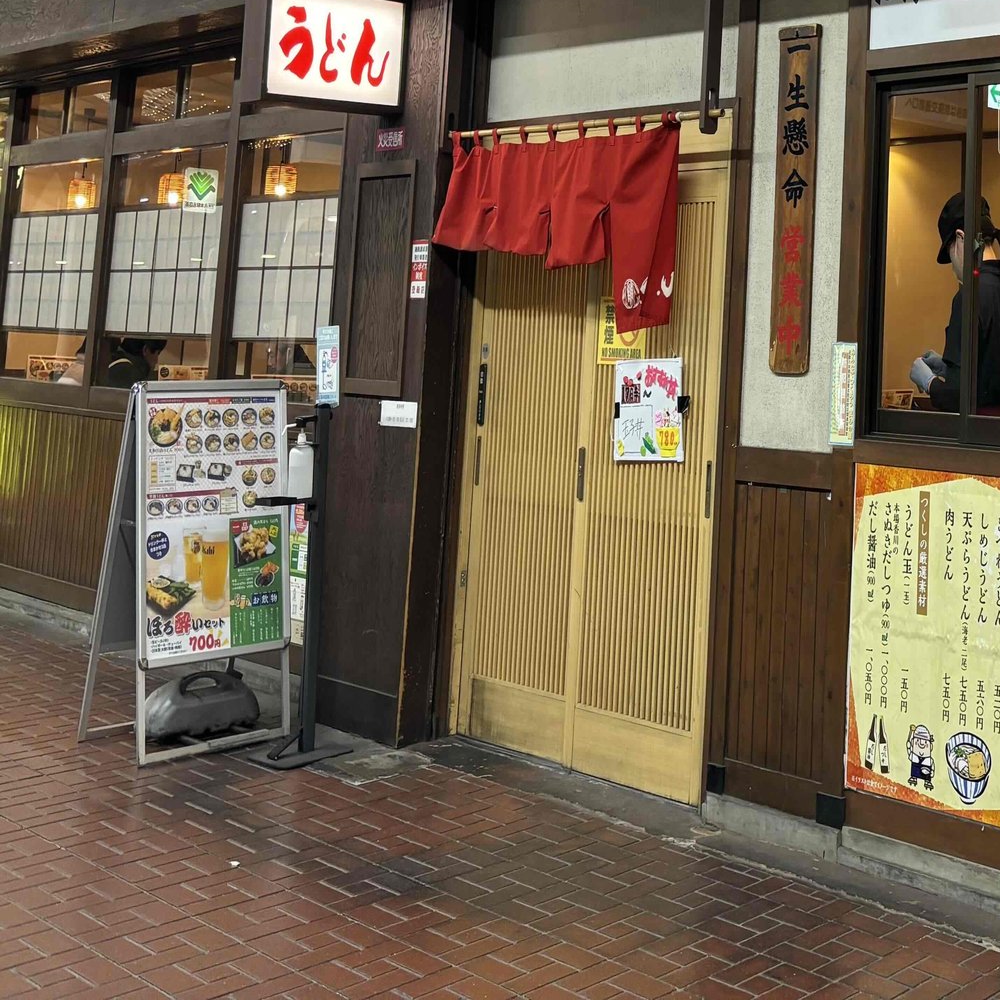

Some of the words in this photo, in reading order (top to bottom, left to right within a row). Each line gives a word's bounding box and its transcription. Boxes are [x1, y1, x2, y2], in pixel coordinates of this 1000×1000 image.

[279, 6, 390, 87] うどん
[782, 43, 811, 209] 一生懸命
[943, 508, 955, 581] 肉うどん
[977, 513, 989, 624] しめじうどん
[252, 593, 278, 605] お飲物
[147, 612, 226, 638] ほろ酔いセット
[189, 634, 221, 651] 700円
[900, 668, 909, 713] 一五〇円
[942, 672, 951, 723] 七五〇円
[959, 676, 968, 726] 七五〇円
[975, 680, 985, 730] 五六〇円
